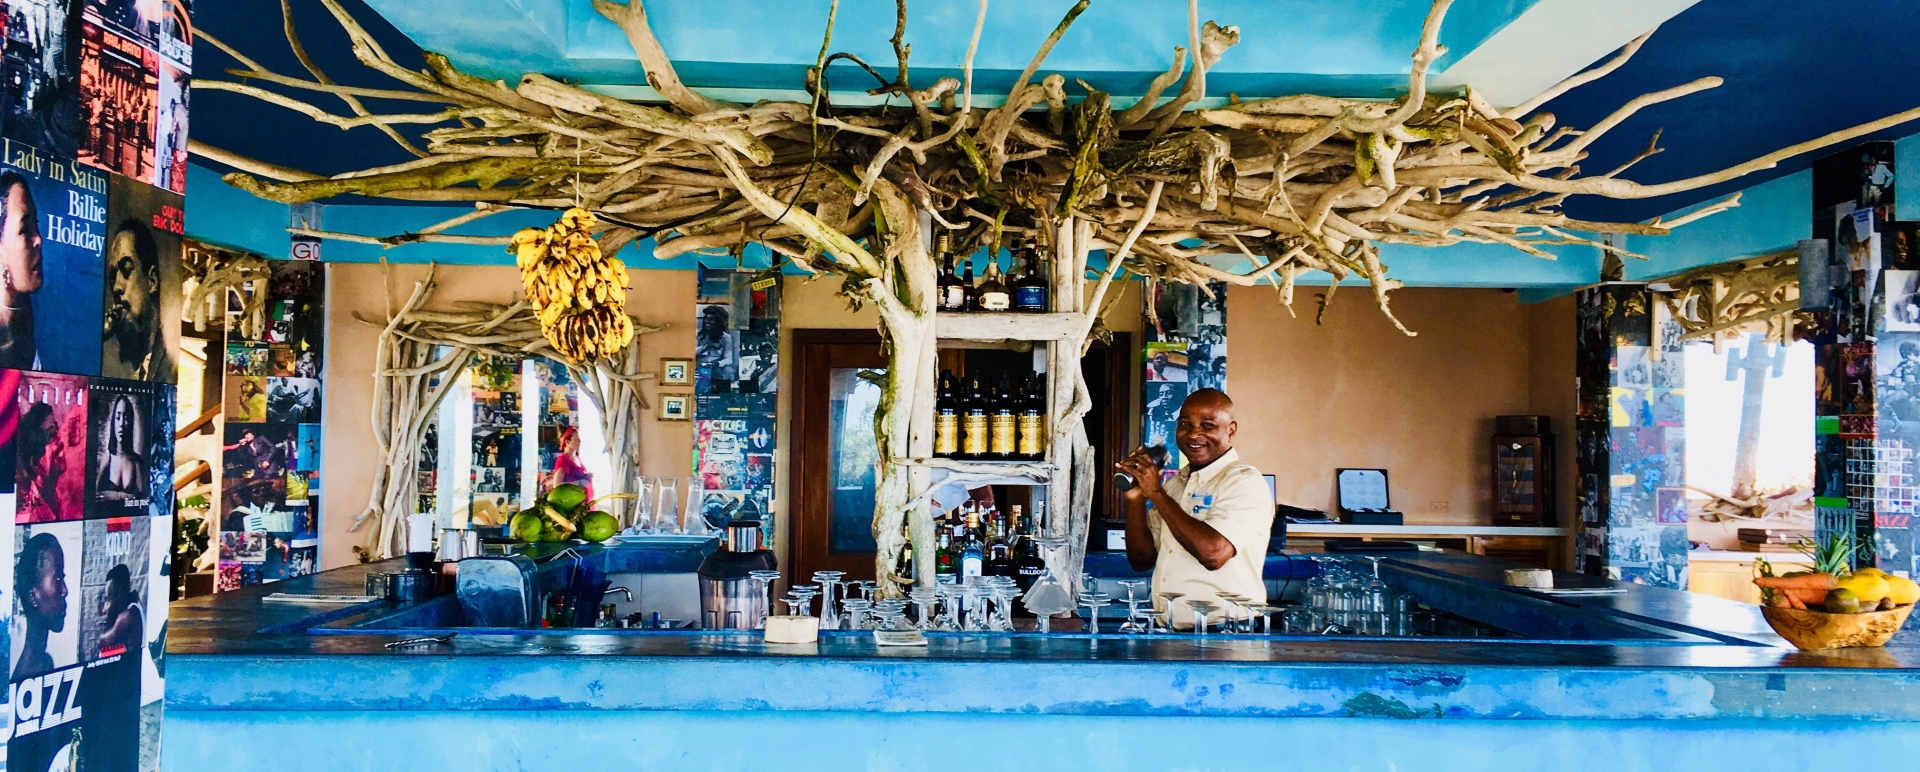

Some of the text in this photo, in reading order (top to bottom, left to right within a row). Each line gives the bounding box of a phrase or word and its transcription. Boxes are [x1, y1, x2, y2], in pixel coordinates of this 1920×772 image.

[3, 137, 107, 195] Lady in Satin
[67, 189, 106, 224] Billie
[46, 214, 105, 258] Holiday
[7, 666, 84, 741] jazz
